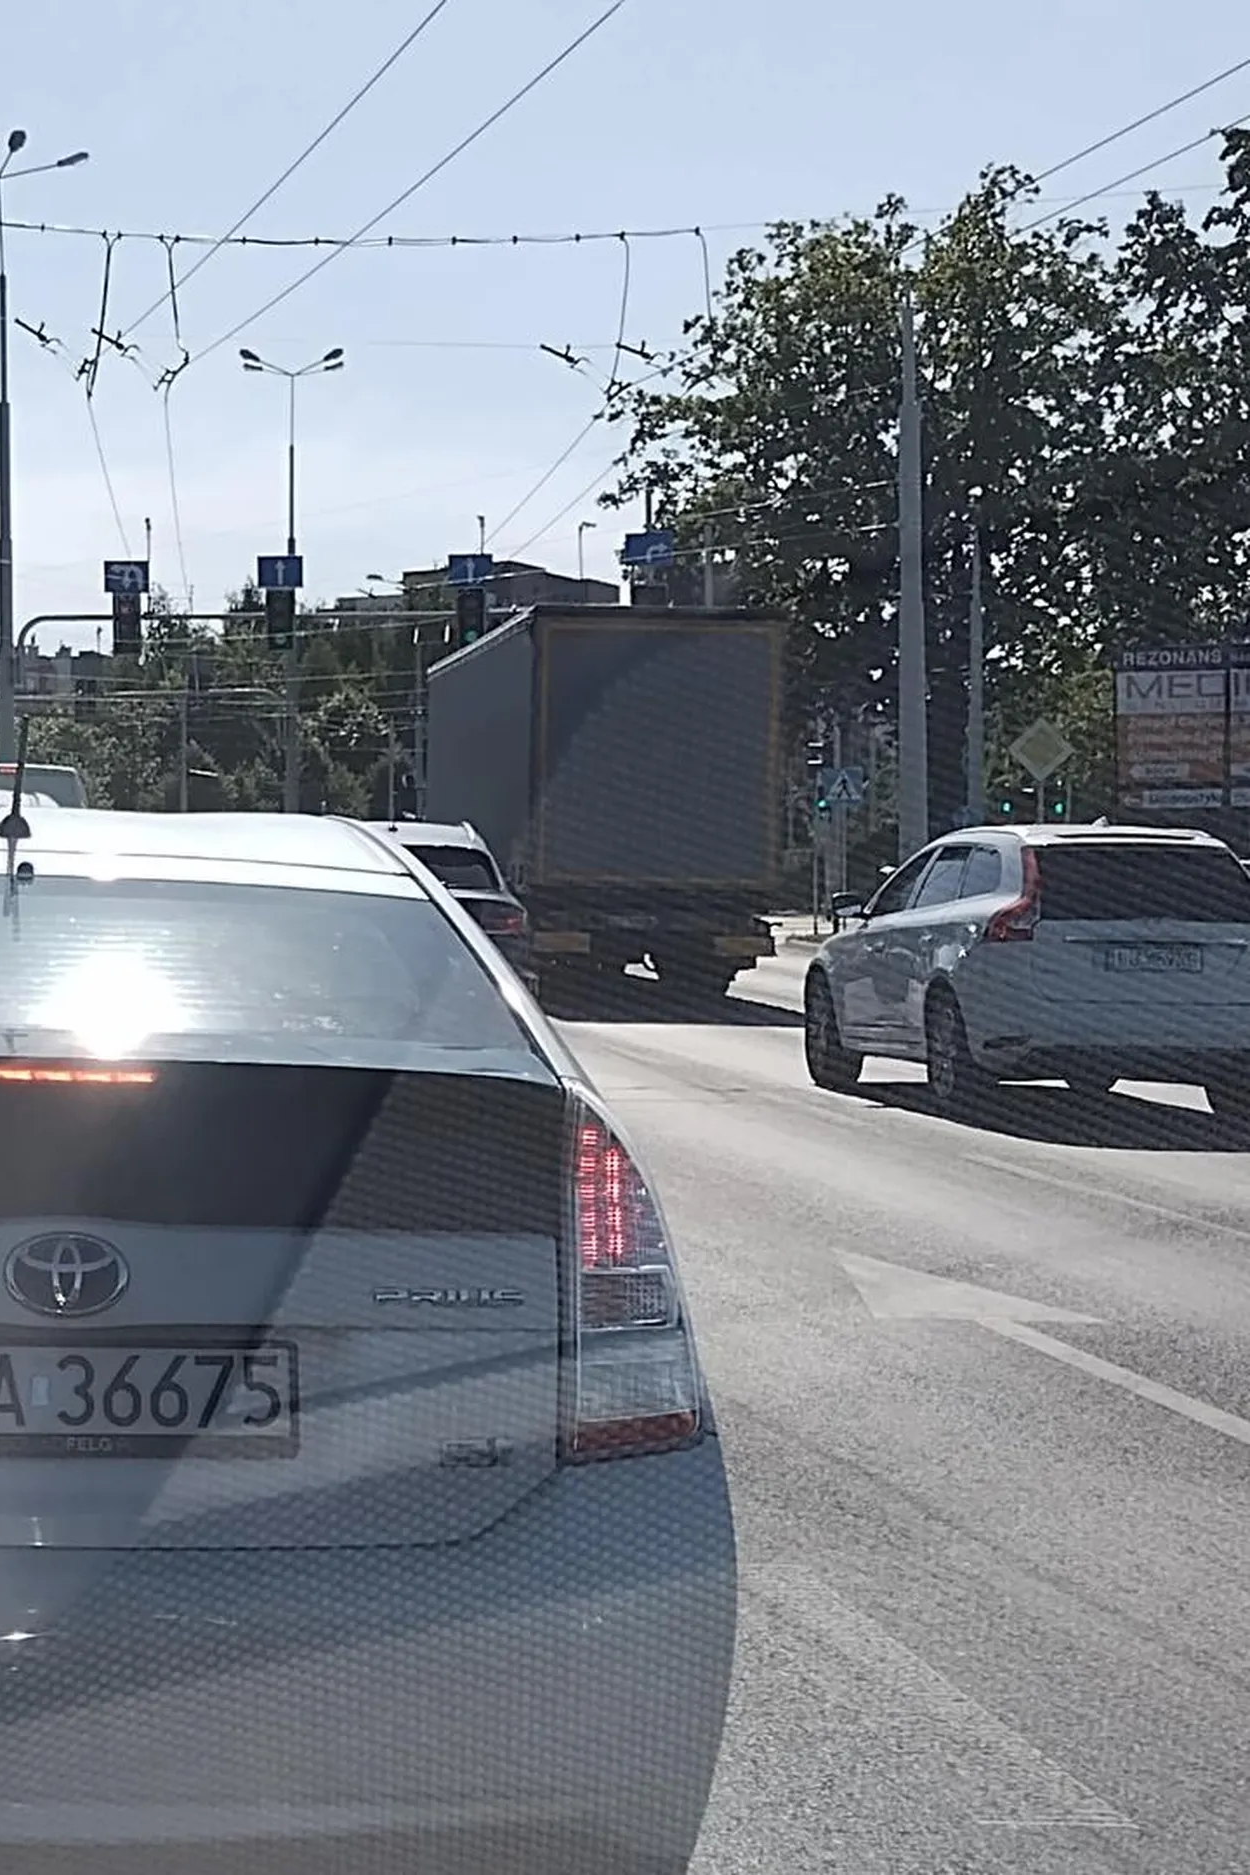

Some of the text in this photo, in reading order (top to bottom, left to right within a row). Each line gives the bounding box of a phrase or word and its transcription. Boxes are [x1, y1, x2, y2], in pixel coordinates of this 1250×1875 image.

[1123, 648, 1222, 667] REZONANS
[373, 1287, 524, 1307] PRIUS
[56, 1354, 282, 1429] 36675
